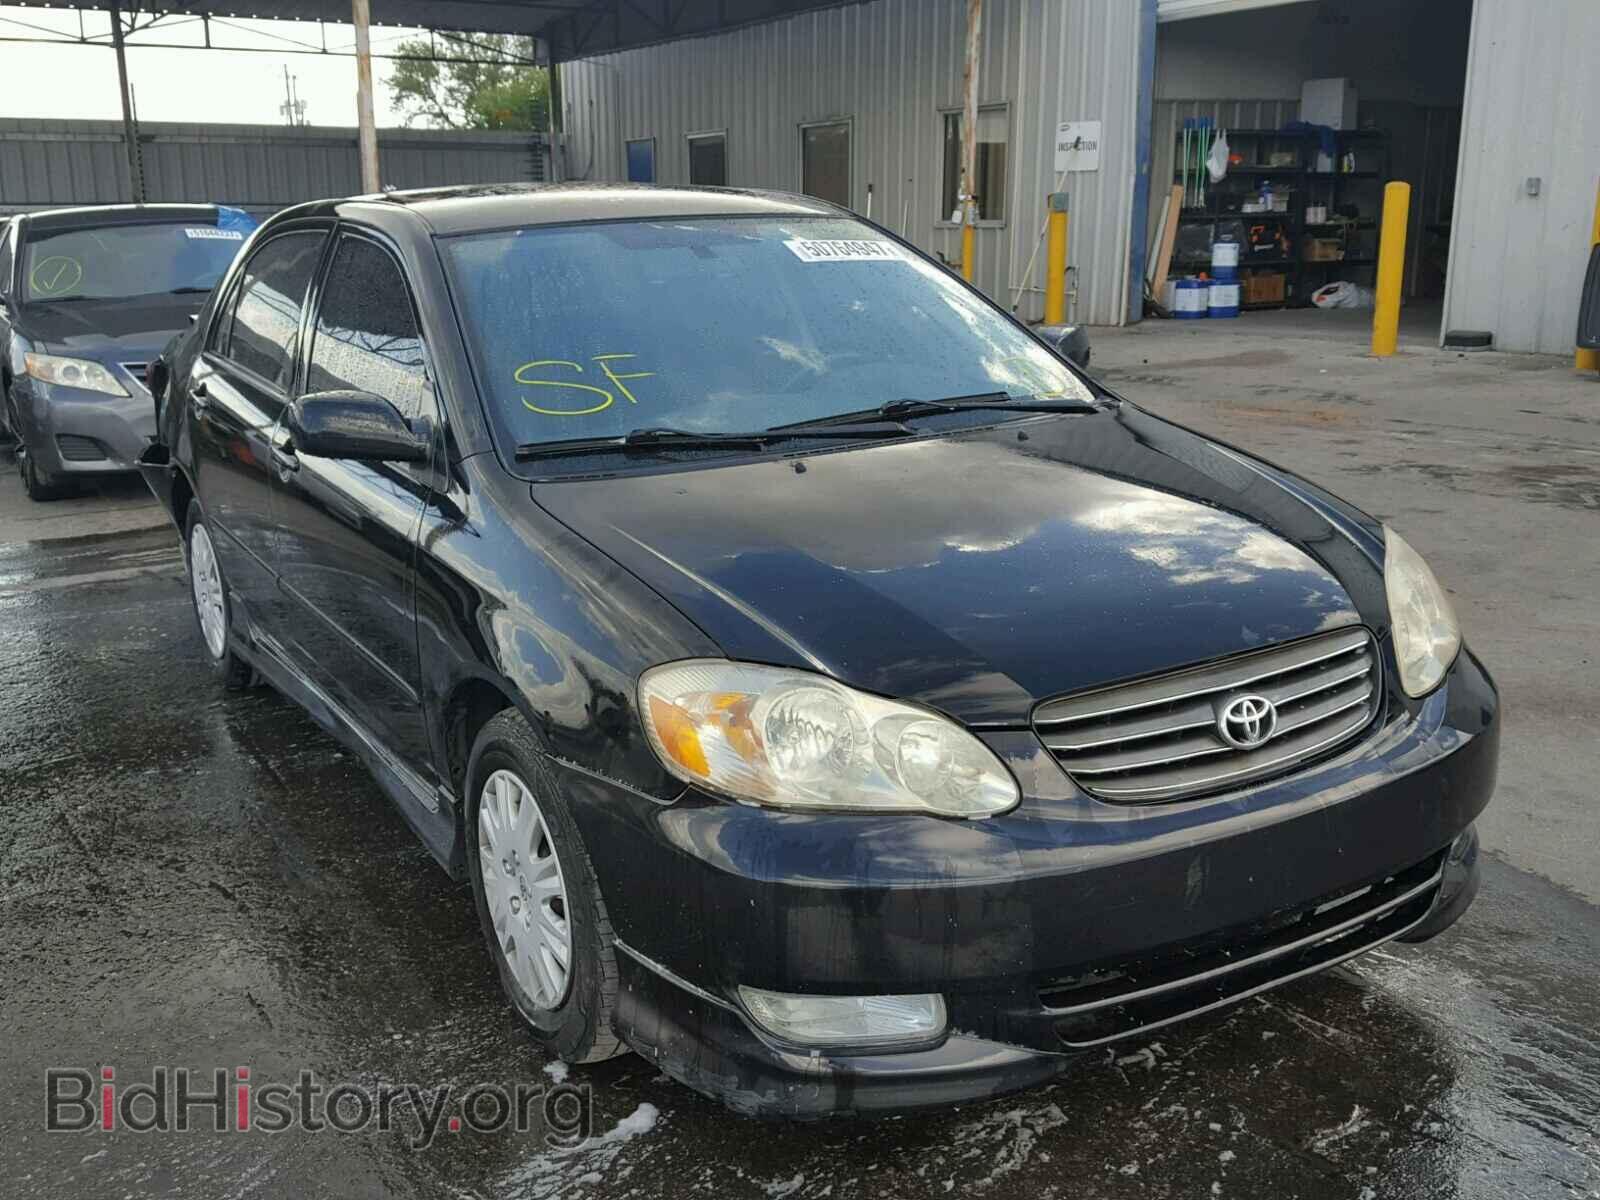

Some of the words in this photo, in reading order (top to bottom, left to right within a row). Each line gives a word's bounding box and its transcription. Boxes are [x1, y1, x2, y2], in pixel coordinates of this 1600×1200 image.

[1058, 141, 1097, 152] INSPCTION
[801, 240, 888, 257] 50764947
[513, 353, 656, 416] SF
